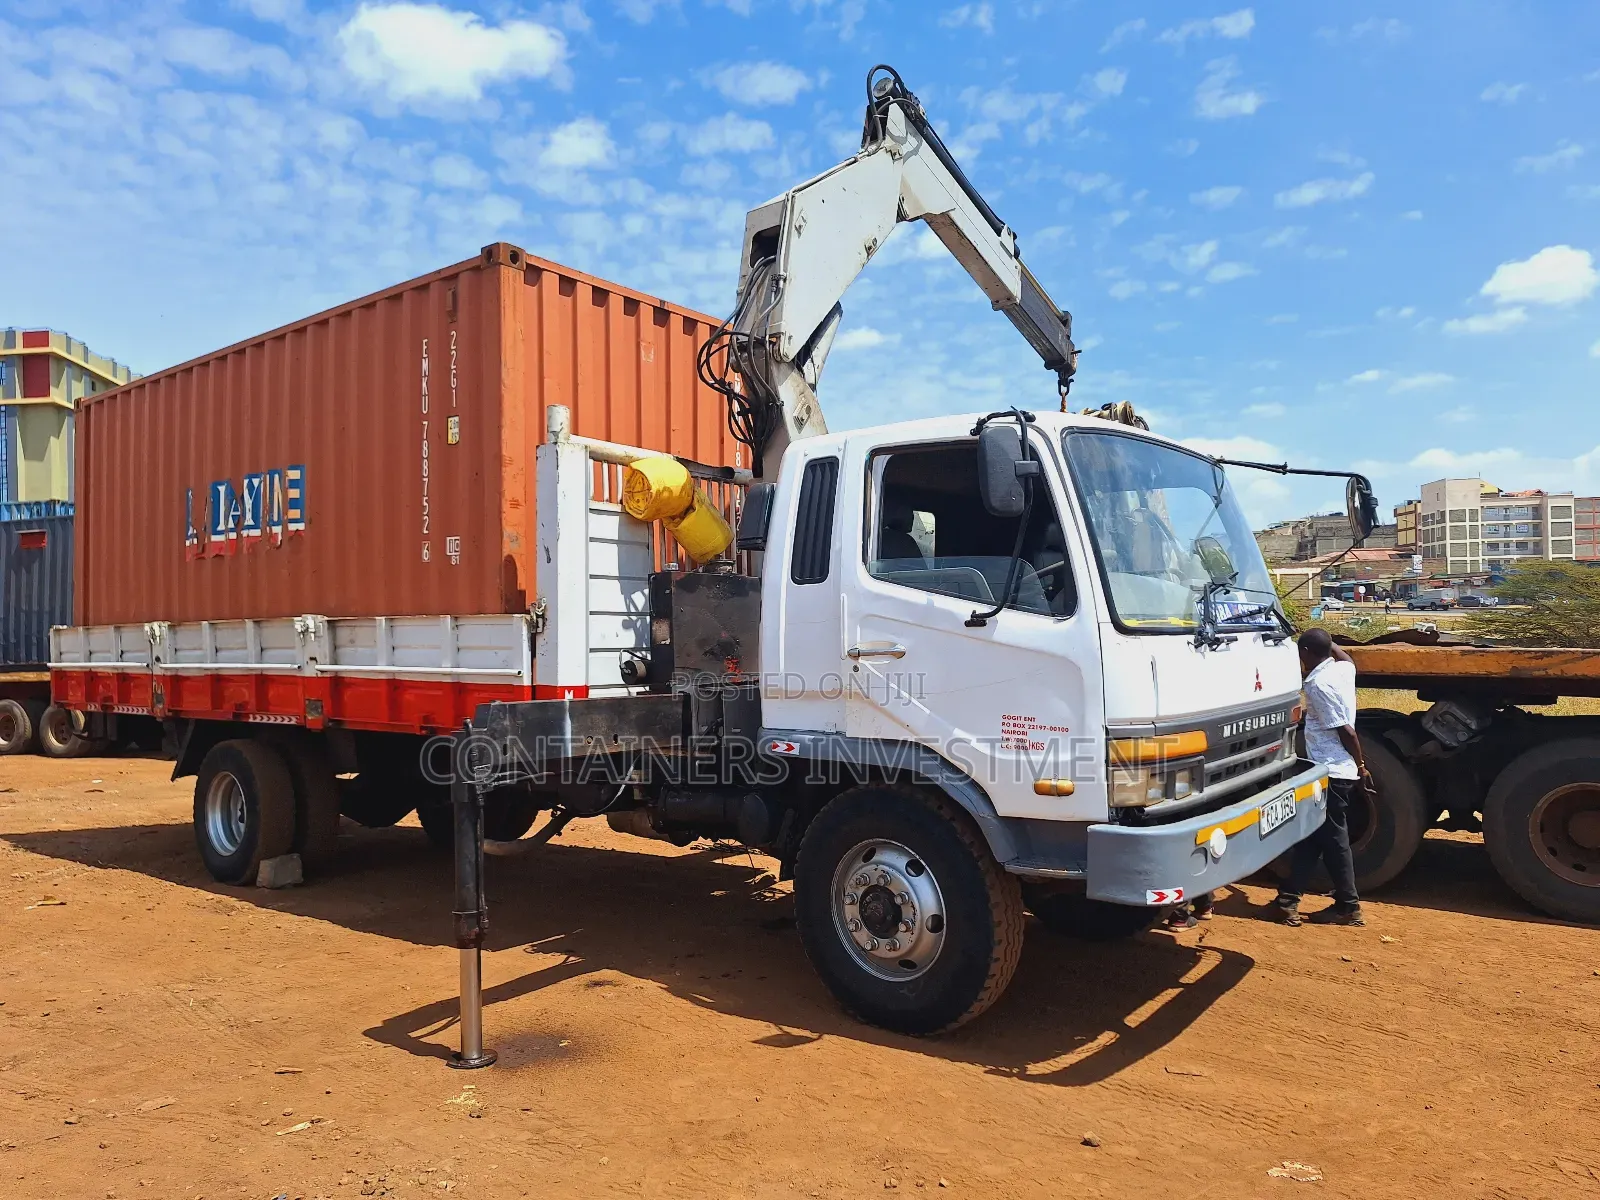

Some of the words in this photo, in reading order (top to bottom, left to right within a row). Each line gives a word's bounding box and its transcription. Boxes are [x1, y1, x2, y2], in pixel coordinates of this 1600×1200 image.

[421, 338, 429, 414] EMKU
[422, 421, 430, 535] 788752
[1001, 728, 1028, 736] NAIROBI
[1222, 711, 1285, 738] MITSUBISHI
